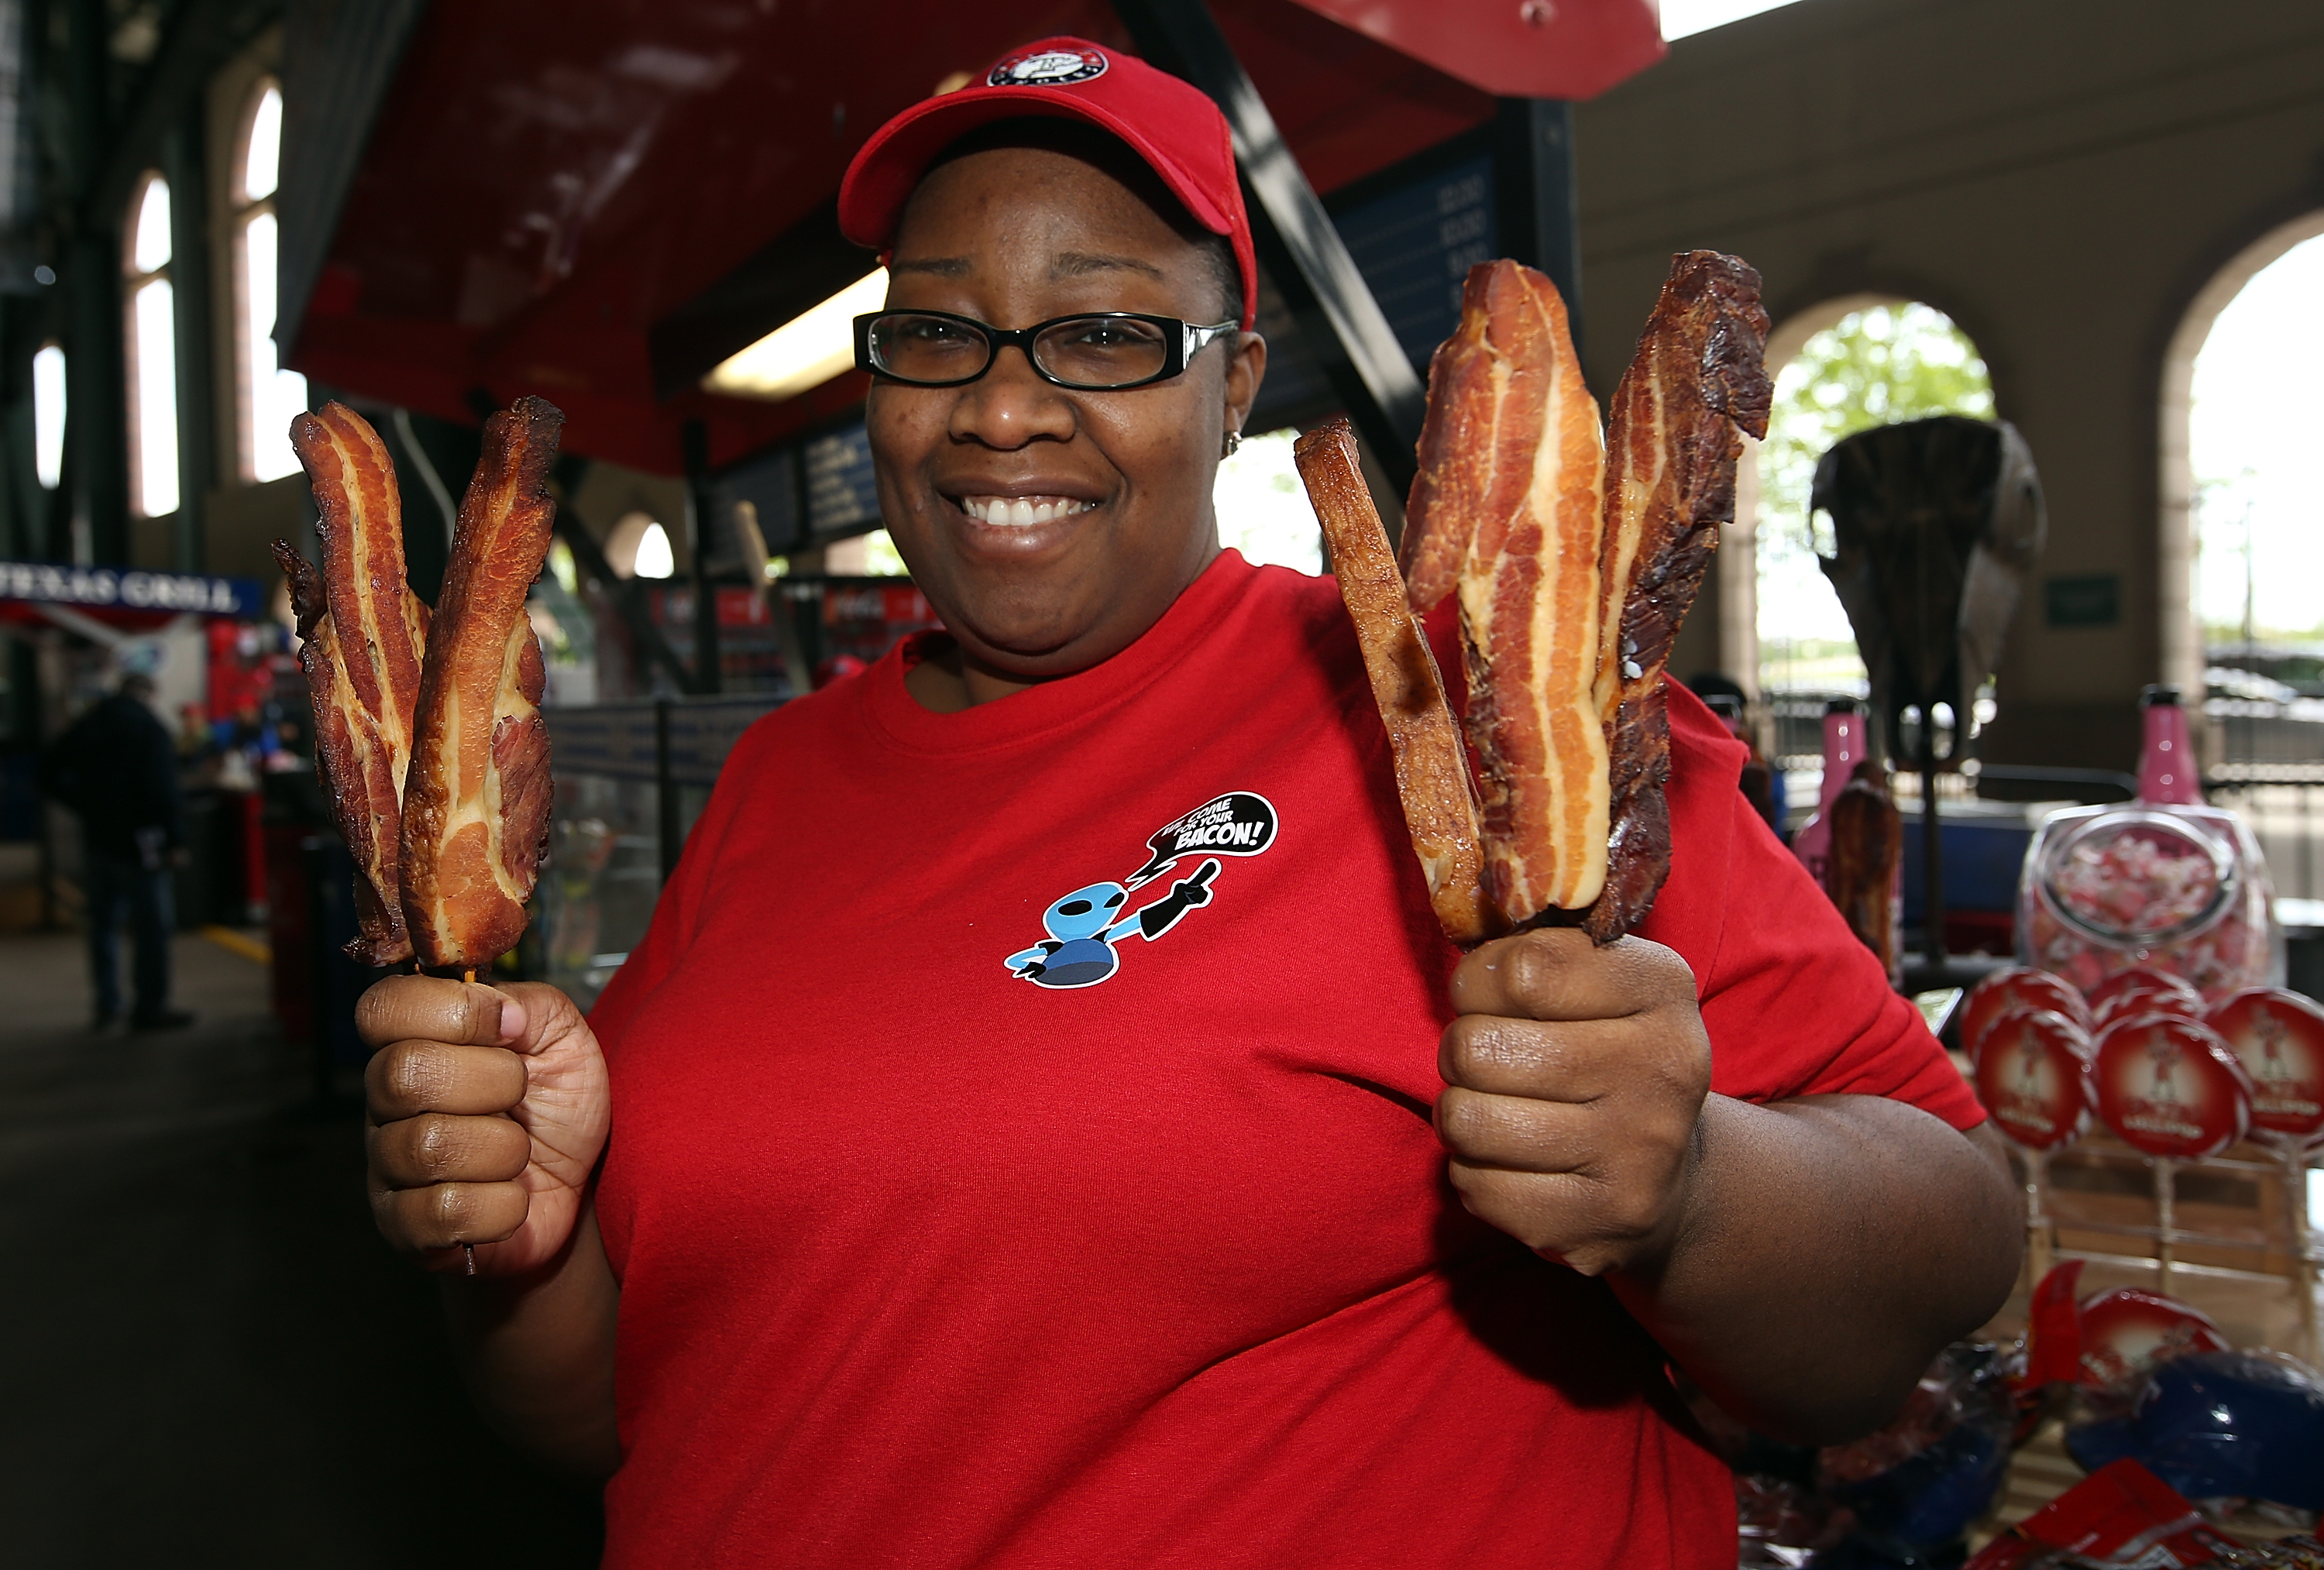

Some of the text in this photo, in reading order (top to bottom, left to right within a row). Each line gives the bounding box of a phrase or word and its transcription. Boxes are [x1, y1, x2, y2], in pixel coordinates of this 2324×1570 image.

[1173, 810, 1233, 837] FOR YOUR
[1188, 797, 1232, 823] COME
[1174, 821, 1265, 850] BACON!
